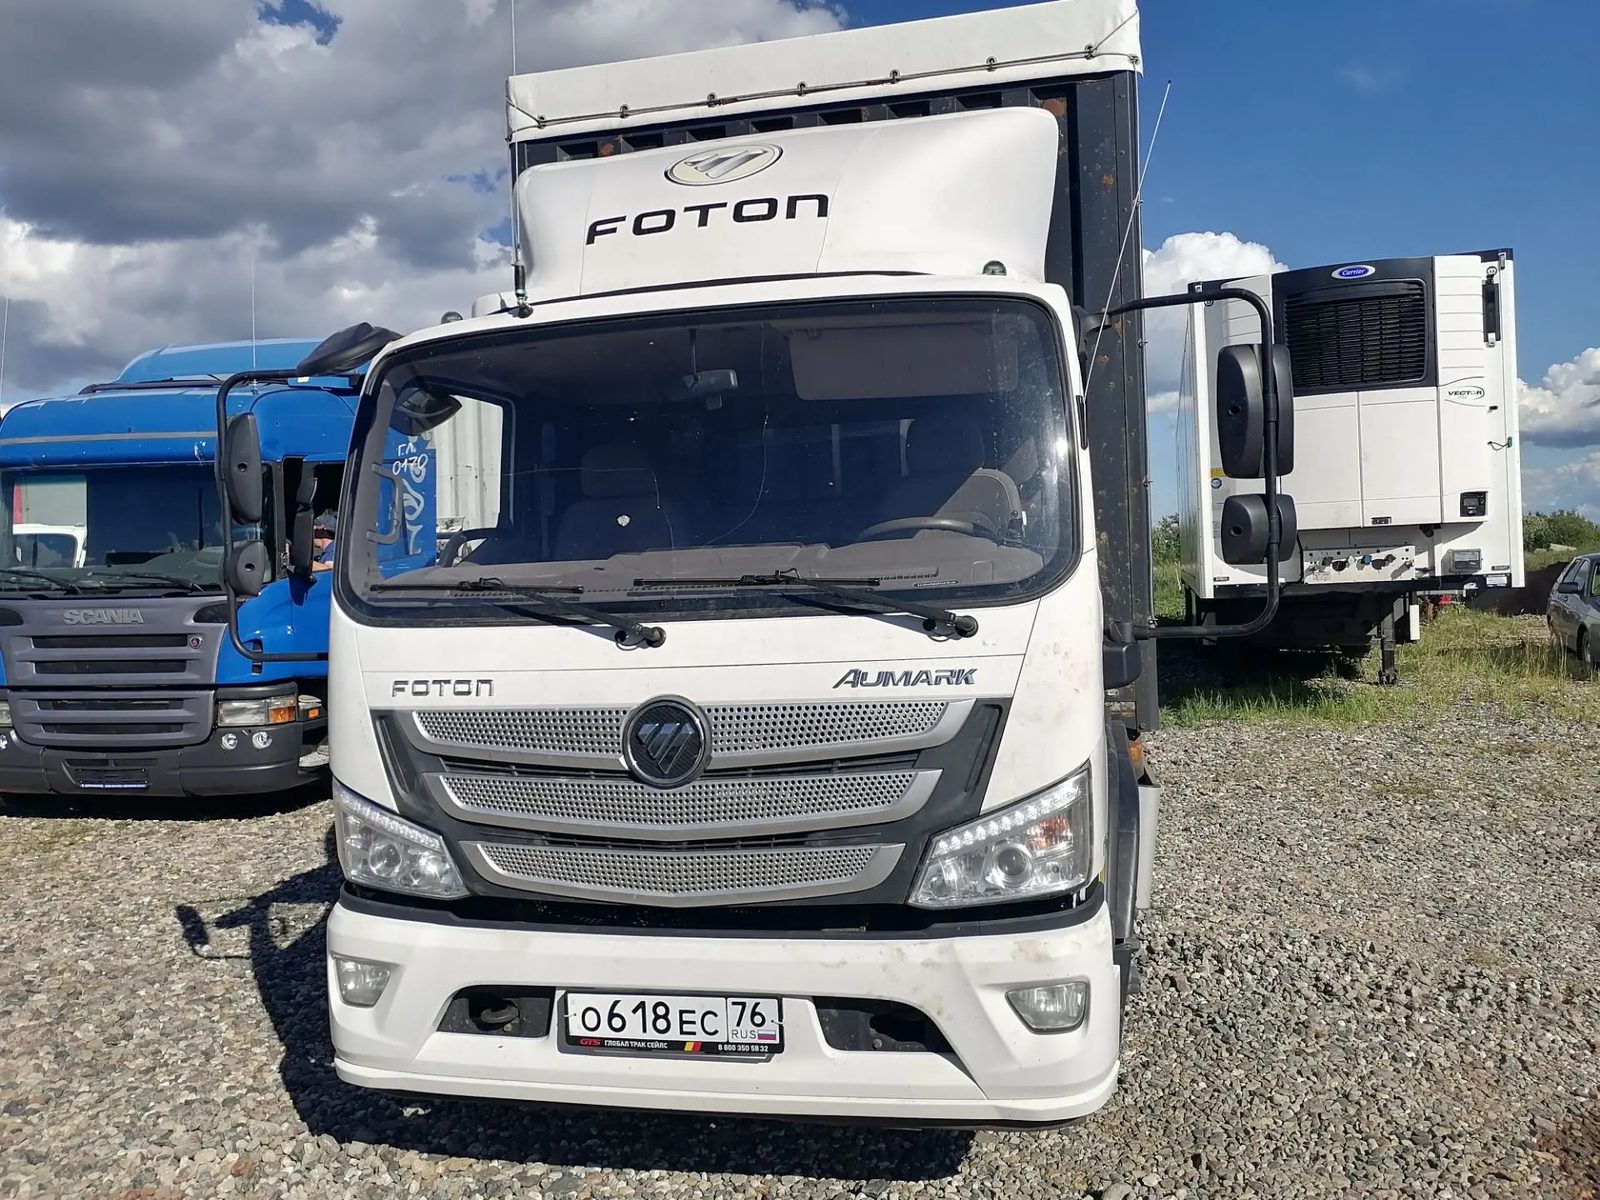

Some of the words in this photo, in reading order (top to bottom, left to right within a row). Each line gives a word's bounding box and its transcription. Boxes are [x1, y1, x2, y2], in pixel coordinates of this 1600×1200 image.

[585, 193, 829, 246] FOTON
[1341, 267, 1366, 277] Carrier
[63, 608, 144, 625] SCANIA
[832, 668, 978, 689] AUMARK
[391, 679, 494, 697] FOTON
[731, 1001, 767, 1028] 76
[731, 1029, 757, 1039] RUS
[646, 1041, 668, 1049] СЕЙЛС
